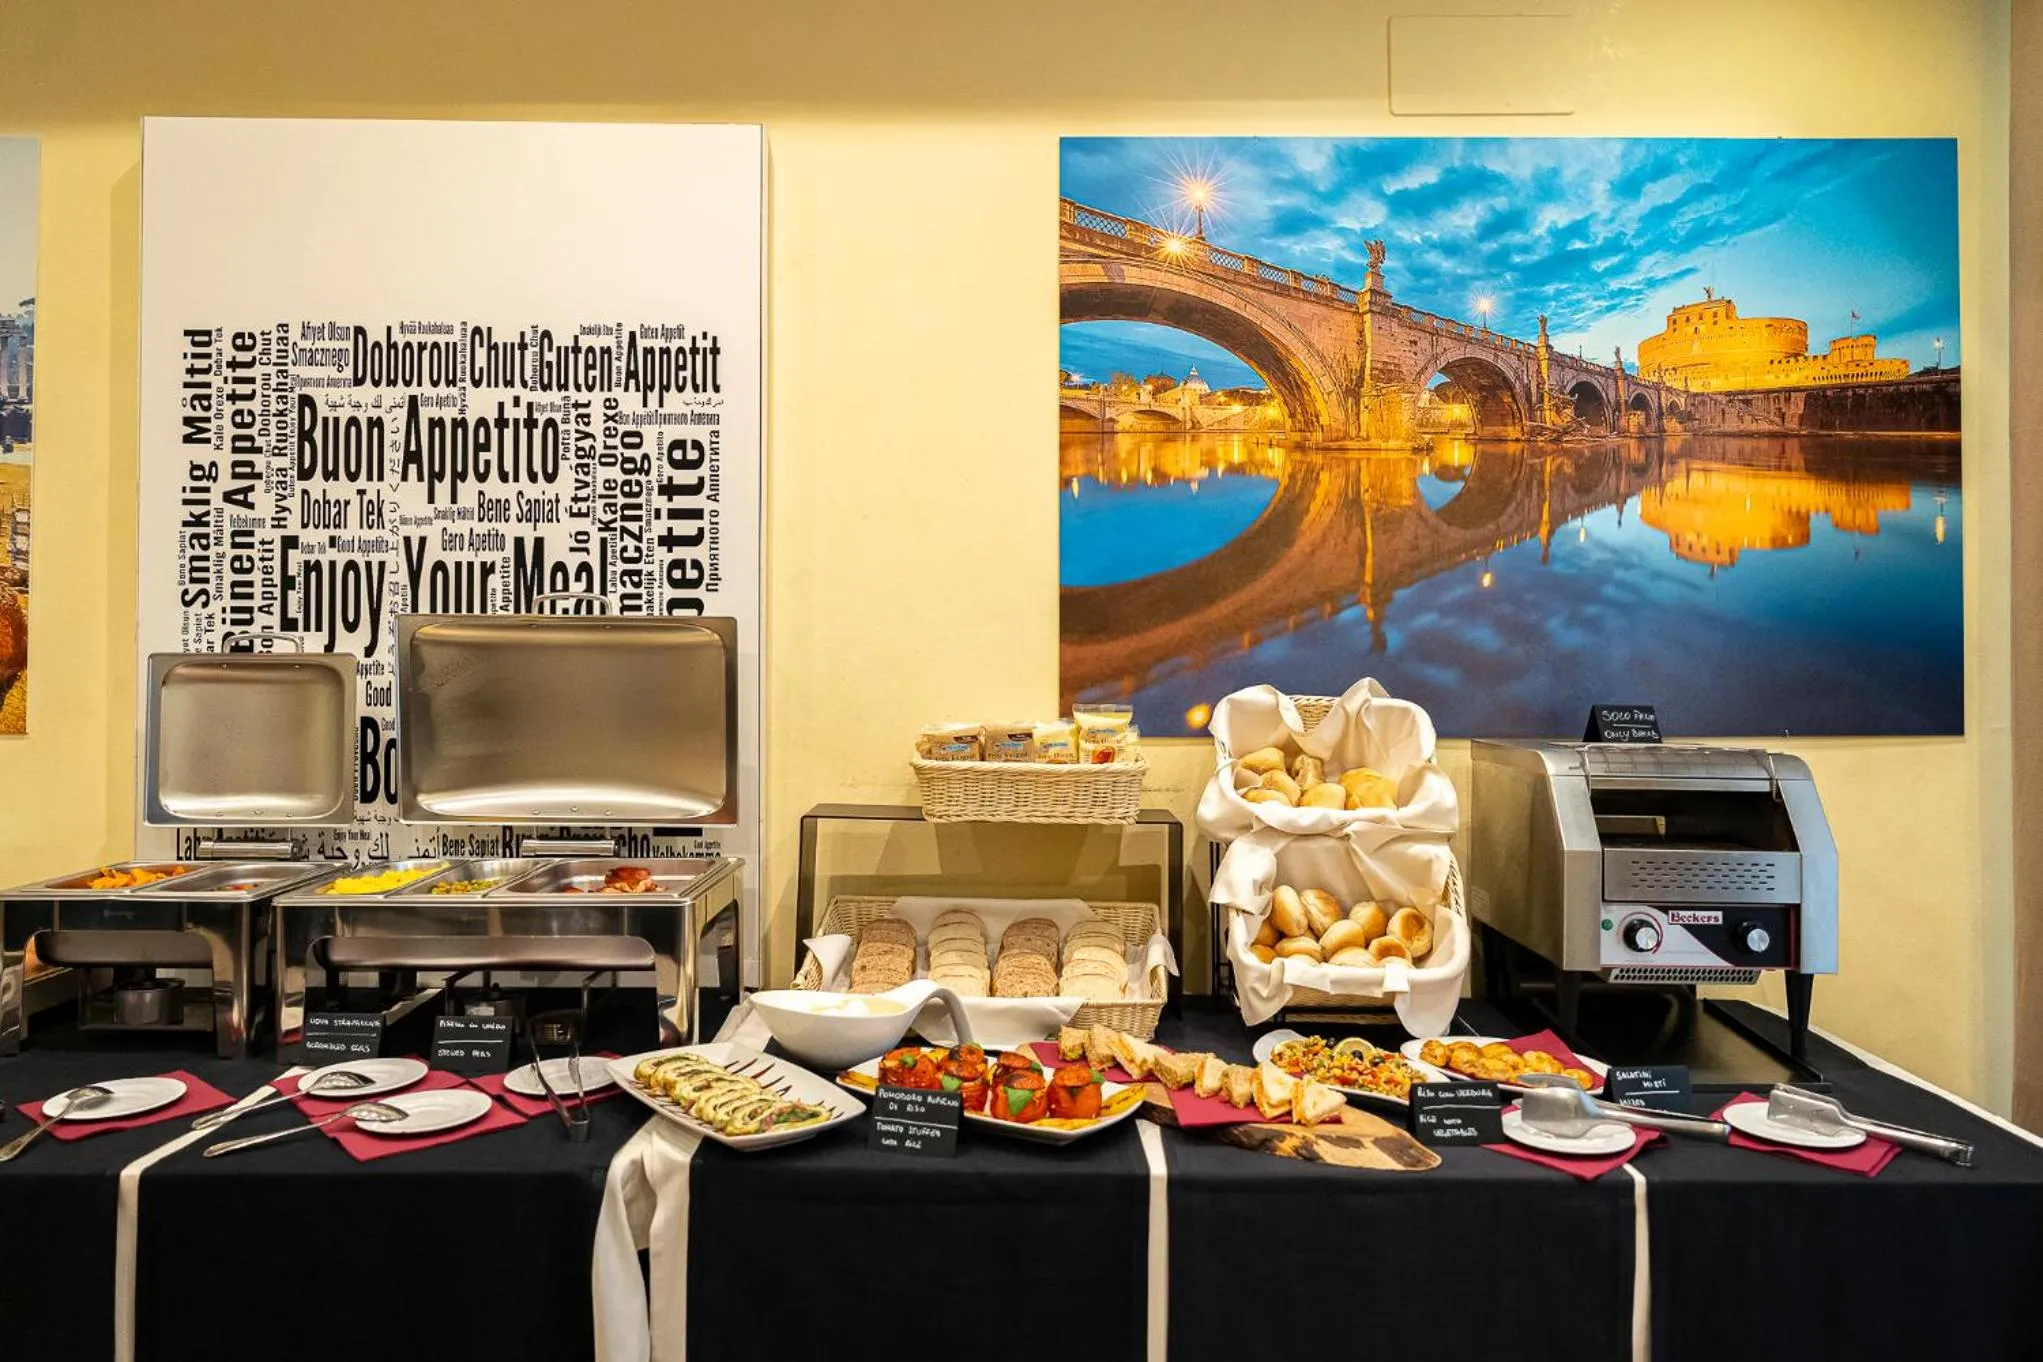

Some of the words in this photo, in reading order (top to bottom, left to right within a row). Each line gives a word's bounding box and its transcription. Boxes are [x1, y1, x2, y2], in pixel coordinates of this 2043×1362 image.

[258, 329, 272, 366] Chut
[291, 341, 350, 373] Smacznego
[327, 321, 350, 342] Olsun
[353, 325, 458, 388] Doborou
[470, 325, 528, 389] Chut
[181, 329, 213, 445] Måltid
[271, 323, 290, 457] Ruokahaluaa
[539, 329, 613, 393] Guten
[623, 330, 721, 408] Appetit
[214, 386, 224, 420] Orexe
[222, 331, 263, 511] Appetite
[258, 372, 272, 438] Doborou
[214, 423, 224, 451] Kale
[297, 393, 385, 483] Buon
[400, 394, 560, 504] Appetito
[565, 399, 597, 520] Étvágyat
[598, 397, 618, 468] Orexe
[705, 429, 720, 504] Аппетита
[270, 467, 292, 530] Hyvää
[300, 489, 350, 530] Dobar
[356, 488, 385, 530] Tek
[477, 489, 511, 524] Bene
[515, 489, 561, 532] Sapiat
[598, 478, 618, 533] Kale
[181, 460, 219, 610] Smaklig
[213, 507, 224, 547] Måltid
[468, 527, 506, 557] Apetito
[569, 530, 592, 556] Jó
[644, 537, 654, 565] Eten
[705, 510, 721, 593] Приятного
[212, 551, 226, 601] Smaklig
[257, 536, 278, 616] Appétit
[280, 534, 386, 658] Enjoy
[402, 535, 497, 615] Your
[499, 556, 512, 612] Appetite
[203, 612, 215, 636] Tek
[365, 680, 392, 707] Good
[441, 833, 468, 857] Bene
[1670, 912, 1720, 923] Beckers
